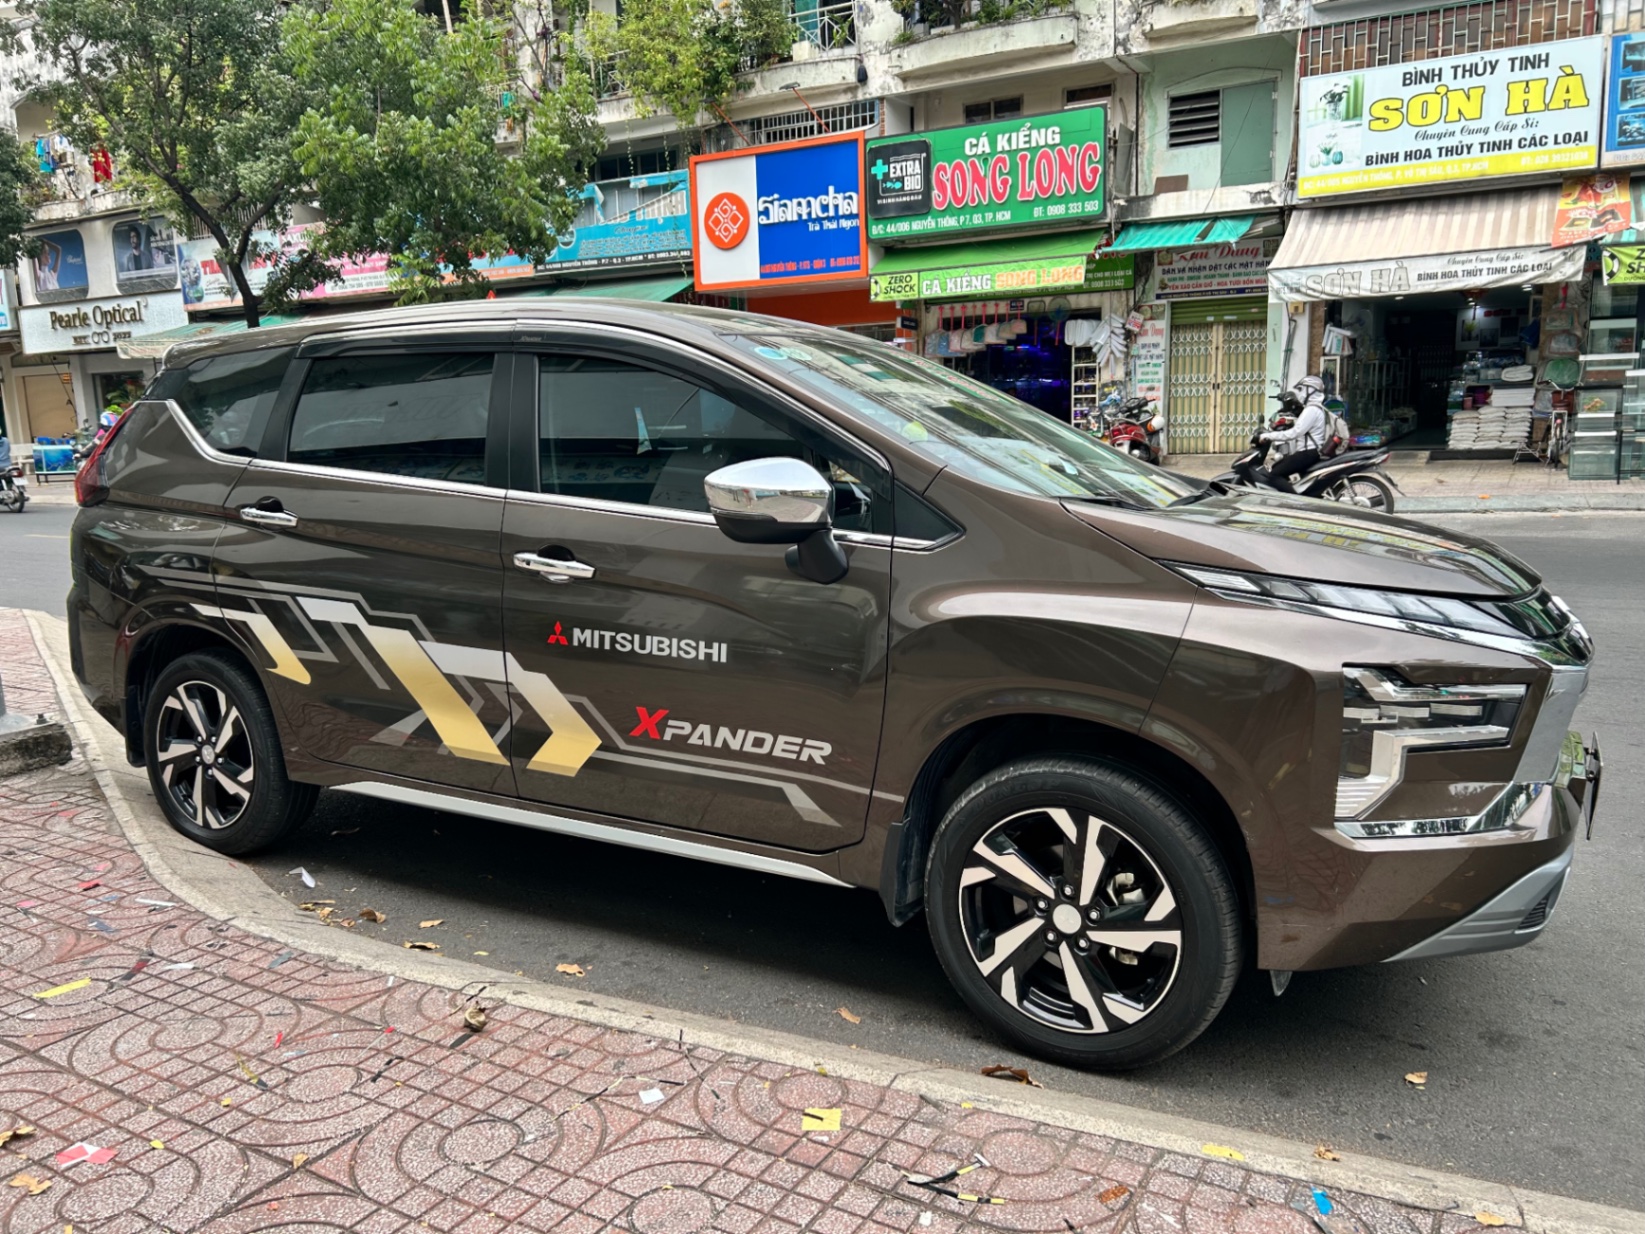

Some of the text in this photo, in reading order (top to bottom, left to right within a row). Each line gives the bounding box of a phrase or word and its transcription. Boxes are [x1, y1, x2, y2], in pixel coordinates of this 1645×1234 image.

[1402, 53, 1550, 87] BÌNH THỦY TINH
[1368, 64, 1590, 132] SƠN HÀ
[964, 122, 1061, 156] CÁ KIỂNG
[1365, 131, 1589, 166] BÌNH HOA THỦY TINH CÁC LOẠI
[1460, 125, 1490, 138] Cung
[890, 160, 921, 178] EXTRA
[904, 175, 921, 190] BIO
[932, 142, 1101, 211] SONG LONG
[758, 185, 858, 224] Siamcha
[996, 210, 1011, 221] HCM
[1034, 201, 1098, 218] ĐT: 0908 333 503
[884, 284, 916, 295] SHOCK
[888, 275, 912, 285] ZERO
[923, 275, 941, 295] CÁ
[995, 269, 1037, 288] SONG
[1040, 265, 1084, 285] LONG
[1306, 268, 1362, 298] SƠN
[1370, 261, 1410, 293] HÀ
[1417, 272, 1438, 281] BÌNH
[1440, 270, 1458, 279] HOA
[1461, 266, 1483, 277] THỦY
[1486, 266, 1507, 276] TINH
[50, 301, 144, 330] Pearle Optical
[573, 628, 727, 663] MITSUBISHI
[629, 707, 832, 765] XPANDER
